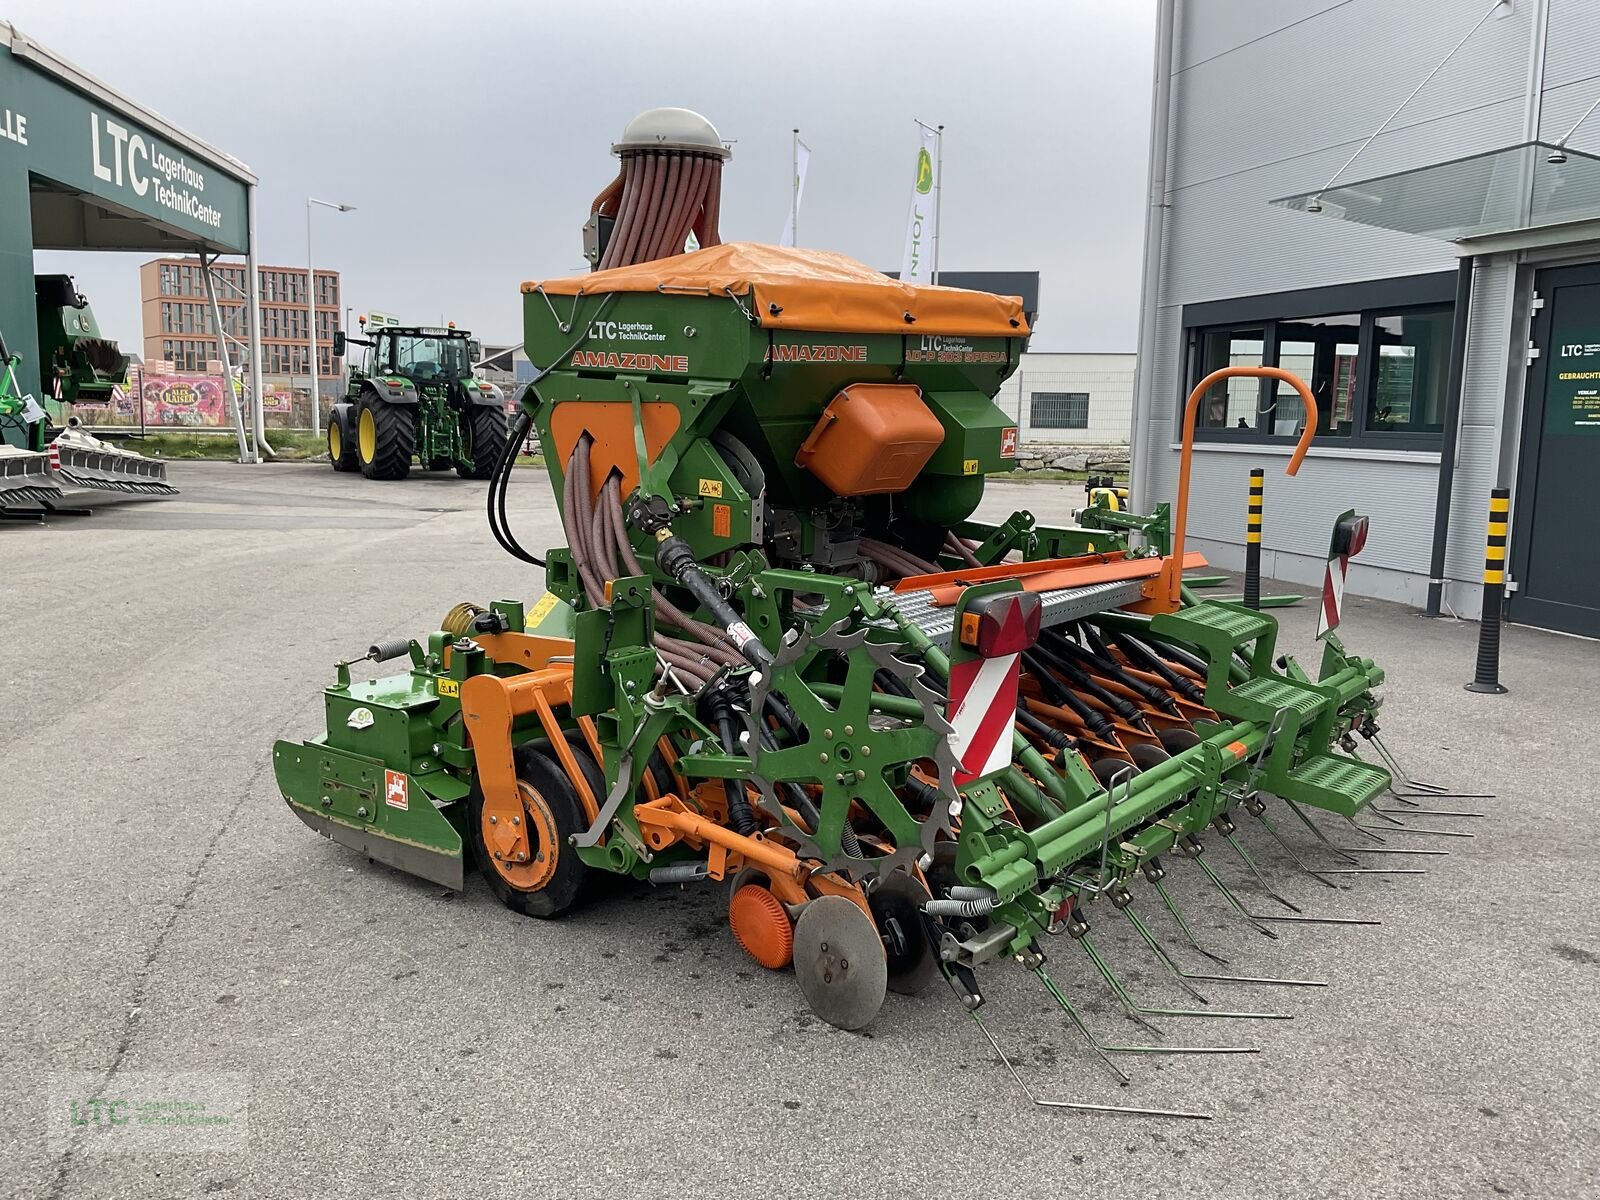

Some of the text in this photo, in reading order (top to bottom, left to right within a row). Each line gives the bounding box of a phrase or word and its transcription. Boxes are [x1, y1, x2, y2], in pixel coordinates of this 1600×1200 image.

[91, 111, 149, 196] LTC
[152, 143, 204, 192] Lagerhaus
[152, 176, 222, 228] TechnikCenter
[911, 204, 924, 276] JOHN
[588, 321, 617, 340] LTC
[618, 322, 653, 331] Lagerhaus
[618, 331, 667, 342] TechnikCenter
[921, 335, 942, 351] LTC
[942, 336, 966, 345] Lagerhaus
[763, 344, 867, 362] AMAZONE
[942, 344, 974, 352] TechnikCenter
[1561, 344, 1583, 357] LTC
[571, 350, 689, 373] AMAZONE
[938, 351, 963, 362] 303
[965, 351, 1013, 363] SPECIA
[165, 392, 195, 403] KAISER
[358, 709, 371, 721] 60
